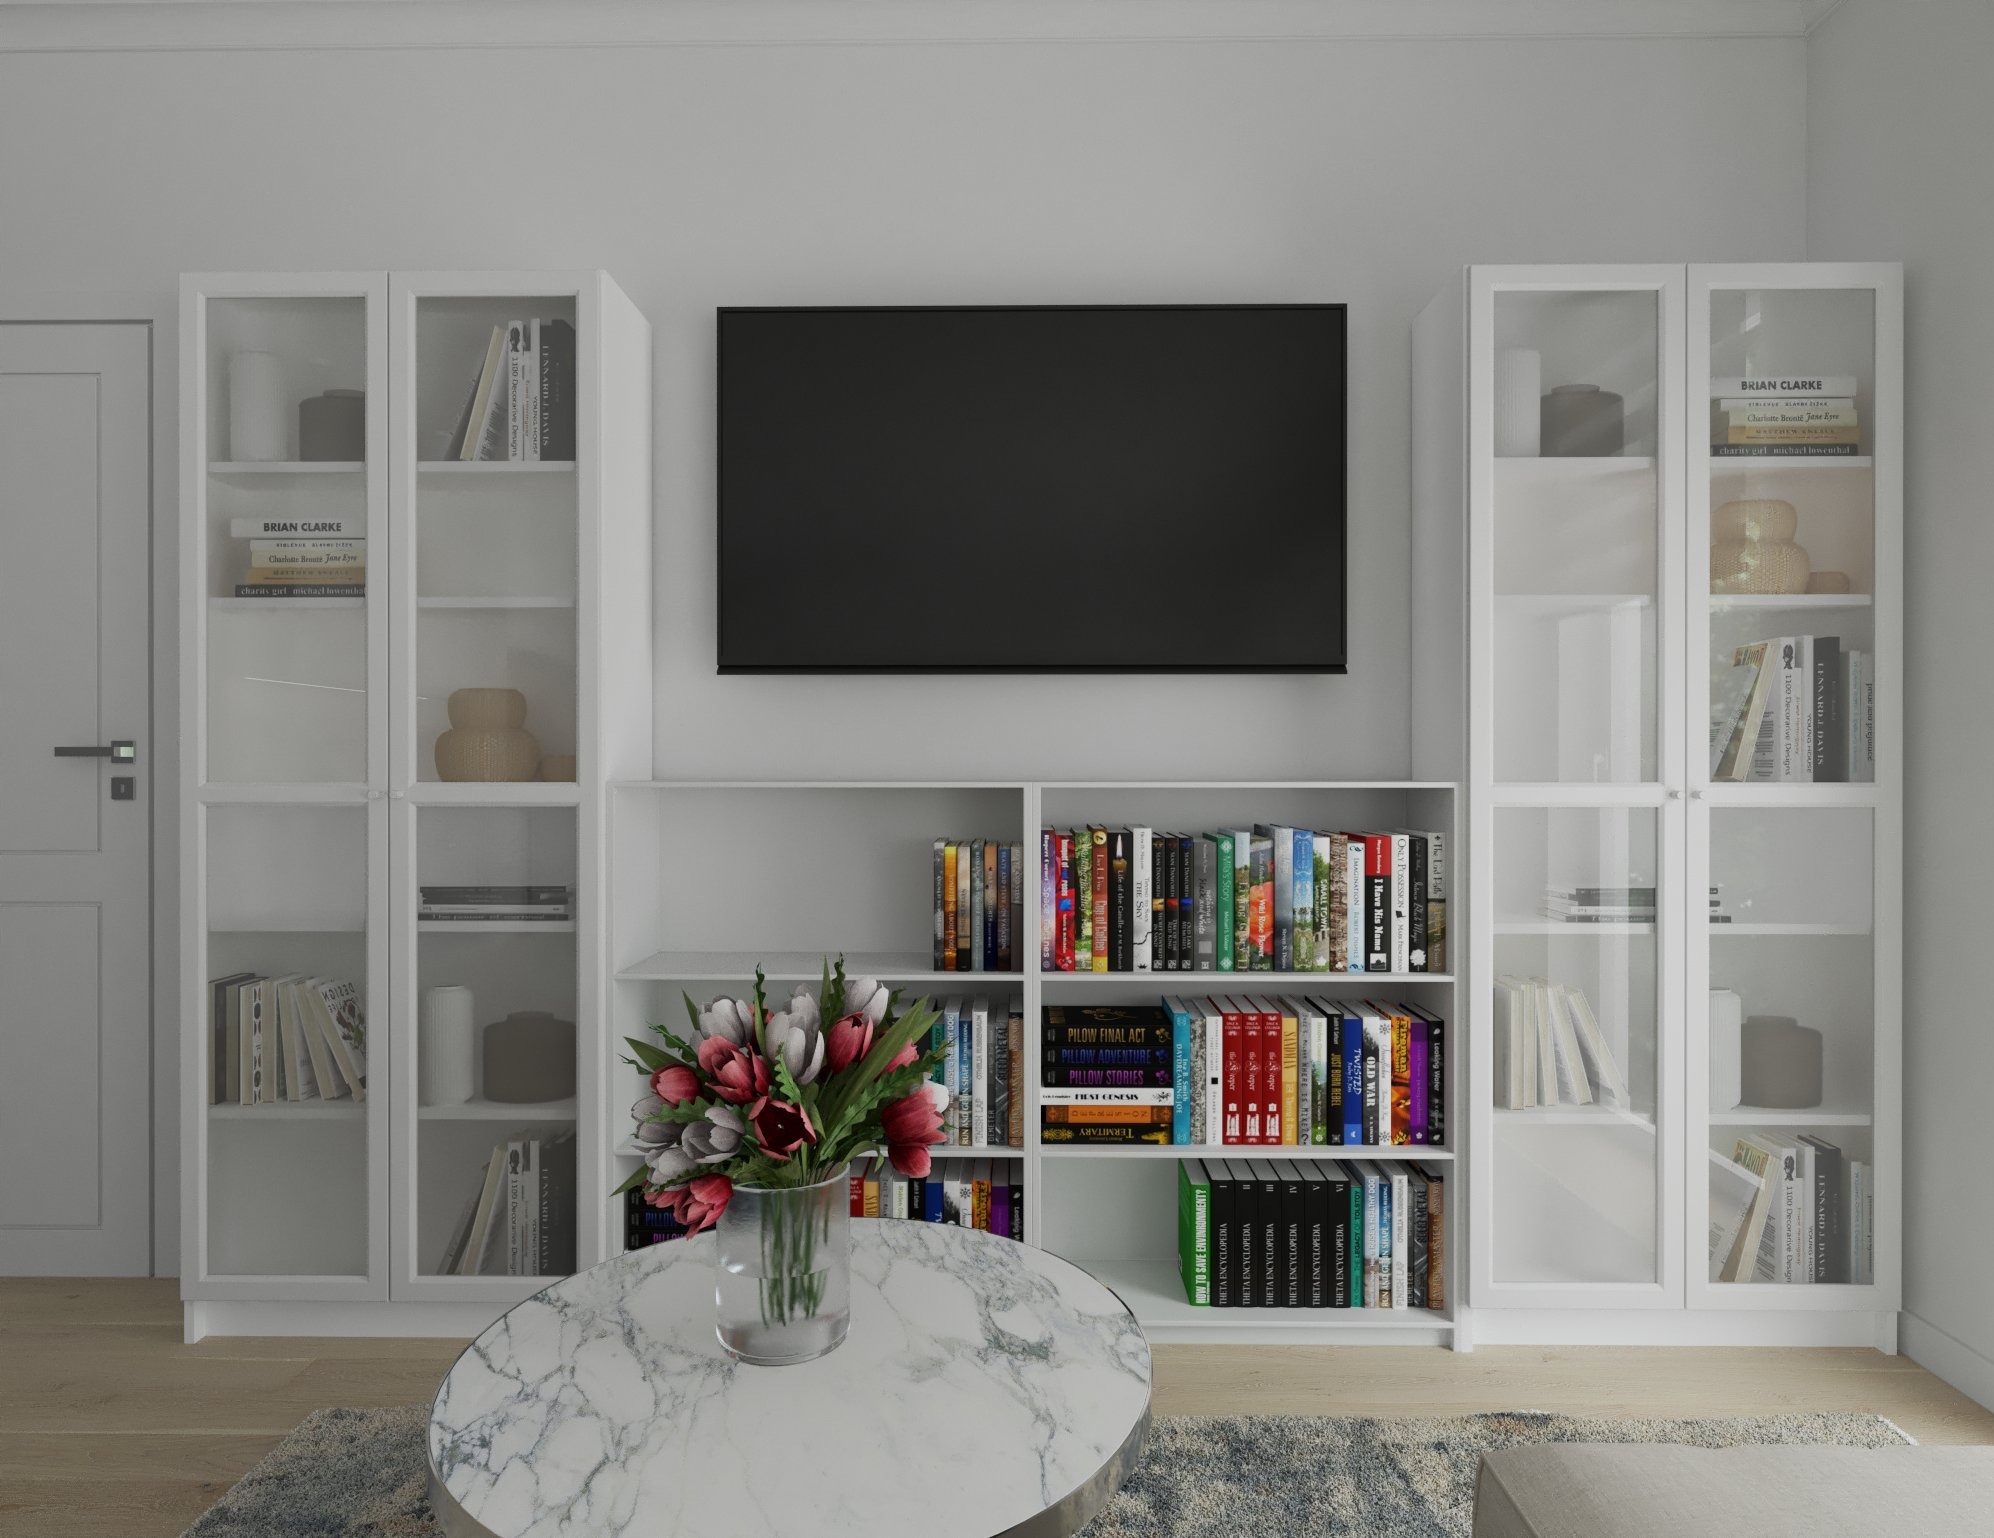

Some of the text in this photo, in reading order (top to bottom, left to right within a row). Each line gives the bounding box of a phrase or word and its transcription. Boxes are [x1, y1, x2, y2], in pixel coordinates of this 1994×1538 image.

[542, 345, 550, 446] LENNARD DAVIS
[1741, 381, 1822, 391] BRIAN CLARKE
[1747, 413, 1779, 422] Charlotte
[1805, 412, 1822, 422] Jane
[1824, 412, 1840, 421] Eyre
[510, 424, 518, 457] Designs
[1719, 445, 1850, 456] charity girl michael lowenthal
[263, 522, 342, 532] BRIAN CLARKE
[268, 553, 357, 564] Charlotte Jane Eyre
[241, 586, 324, 597] charity girl michael
[1783, 743, 1791, 776] Designs
[1398, 838, 1406, 909] ONLY POSSESSION
[1043, 886, 1051, 914] Space
[1118, 884, 1124, 892] of
[1220, 880, 1231, 902] Story
[1238, 882, 1249, 917] Living
[1374, 884, 1383, 907] Have
[1094, 901, 1107, 915] Cup
[1320, 878, 1328, 931] SMALL TOWN
[1374, 908, 1383, 924] His
[1258, 899, 1266, 958] Wild Rose Flower
[1411, 903, 1423, 943] Black Magic
[1095, 926, 1107, 951] Coffee
[1374, 925, 1383, 951] Name
[946, 1015, 954, 1031] DOG
[1067, 1028, 1097, 1043] PILOW
[1100, 1028, 1126, 1043] FINAL
[1128, 1028, 1146, 1043] ACT
[1061, 1049, 1095, 1063] PILLOW
[1098, 1049, 1151, 1064] ADVENTURE
[1283, 1031, 1296, 1069] SANDMAN
[1400, 1020, 1408, 1073] Fireman
[1432, 1042, 1440, 1069] Leaking
[1069, 1070, 1104, 1085] PILLOW
[1106, 1070, 1143, 1085] STORIES
[1175, 1043, 1183, 1100] DAYDREAMING
[1301, 1062, 1309, 1087] WHERE
[1331, 1053, 1342, 1107] JUST BORN REBEL
[1352, 1048, 1362, 1096] TWISTED
[1366, 1056, 1376, 1107] OLD WAR
[961, 1063, 969, 1145] RUN AND SHAPE
[1301, 1092, 1308, 1102] IS
[1079, 1128, 1134, 1138] TERMITARY
[1266, 1184, 1274, 1192] III
[1289, 1185, 1297, 1193] IV
[1336, 1184, 1344, 1192] VI
[1367, 1178, 1375, 1194] DOG
[1786, 1186, 1794, 1206] 1100
[510, 1178, 518, 1245] 1100 Decorative
[1195, 1254, 1206, 1273] SAVE
[1219, 1223, 1227, 1305] THETA ENCYCLOPEDIA
[1242, 1223, 1250, 1305] THETA ENCYCLOPEDIA
[1266, 1224, 1274, 1306] THETA ENCYCLOPEDIA
[1289, 1224, 1297, 1306] THETA ENCYCLOPEDIA
[1312, 1224, 1320, 1306] THETA ENCYCLOPEDIA
[1336, 1224, 1344, 1306] THETA ENCYCLOPEDIA
[1381, 1227, 1389, 1307] RUN AND SHAPE
[1195, 1274, 1206, 1284] TO
[1396, 1261, 1404, 1306] FINISH LAP
[1195, 1286, 1207, 1304] HOW
